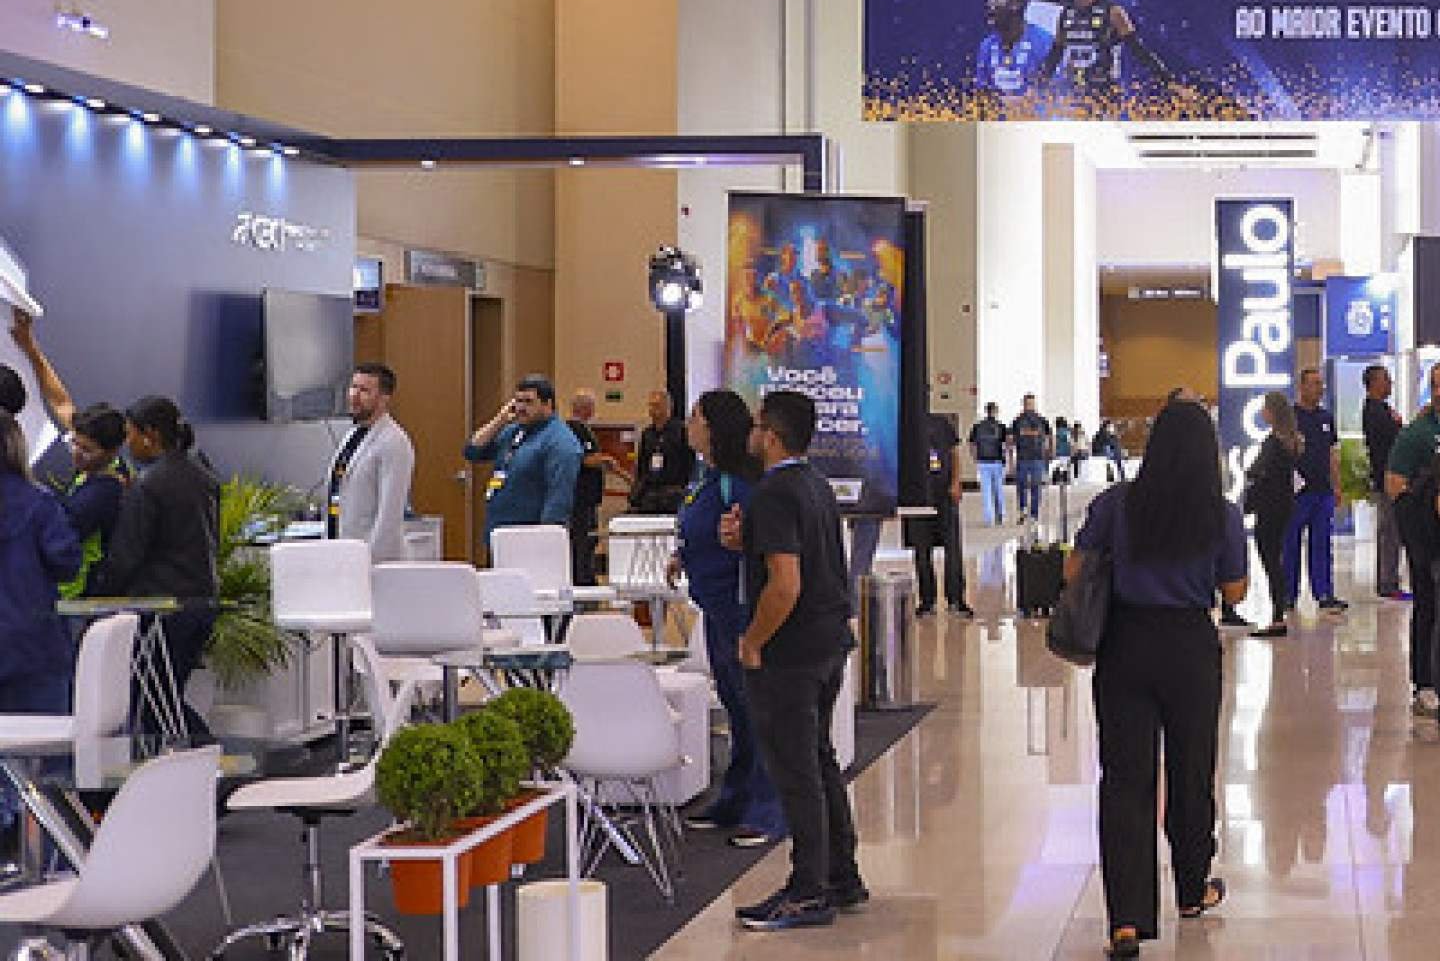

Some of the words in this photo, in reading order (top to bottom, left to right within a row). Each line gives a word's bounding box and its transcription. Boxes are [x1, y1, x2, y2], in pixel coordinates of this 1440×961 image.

[1235, 6, 1266, 39] AO
[1271, 6, 1343, 39] MAIOR
[1347, 6, 1432, 39] EVENTO
[1224, 204, 1292, 388] Paulo
